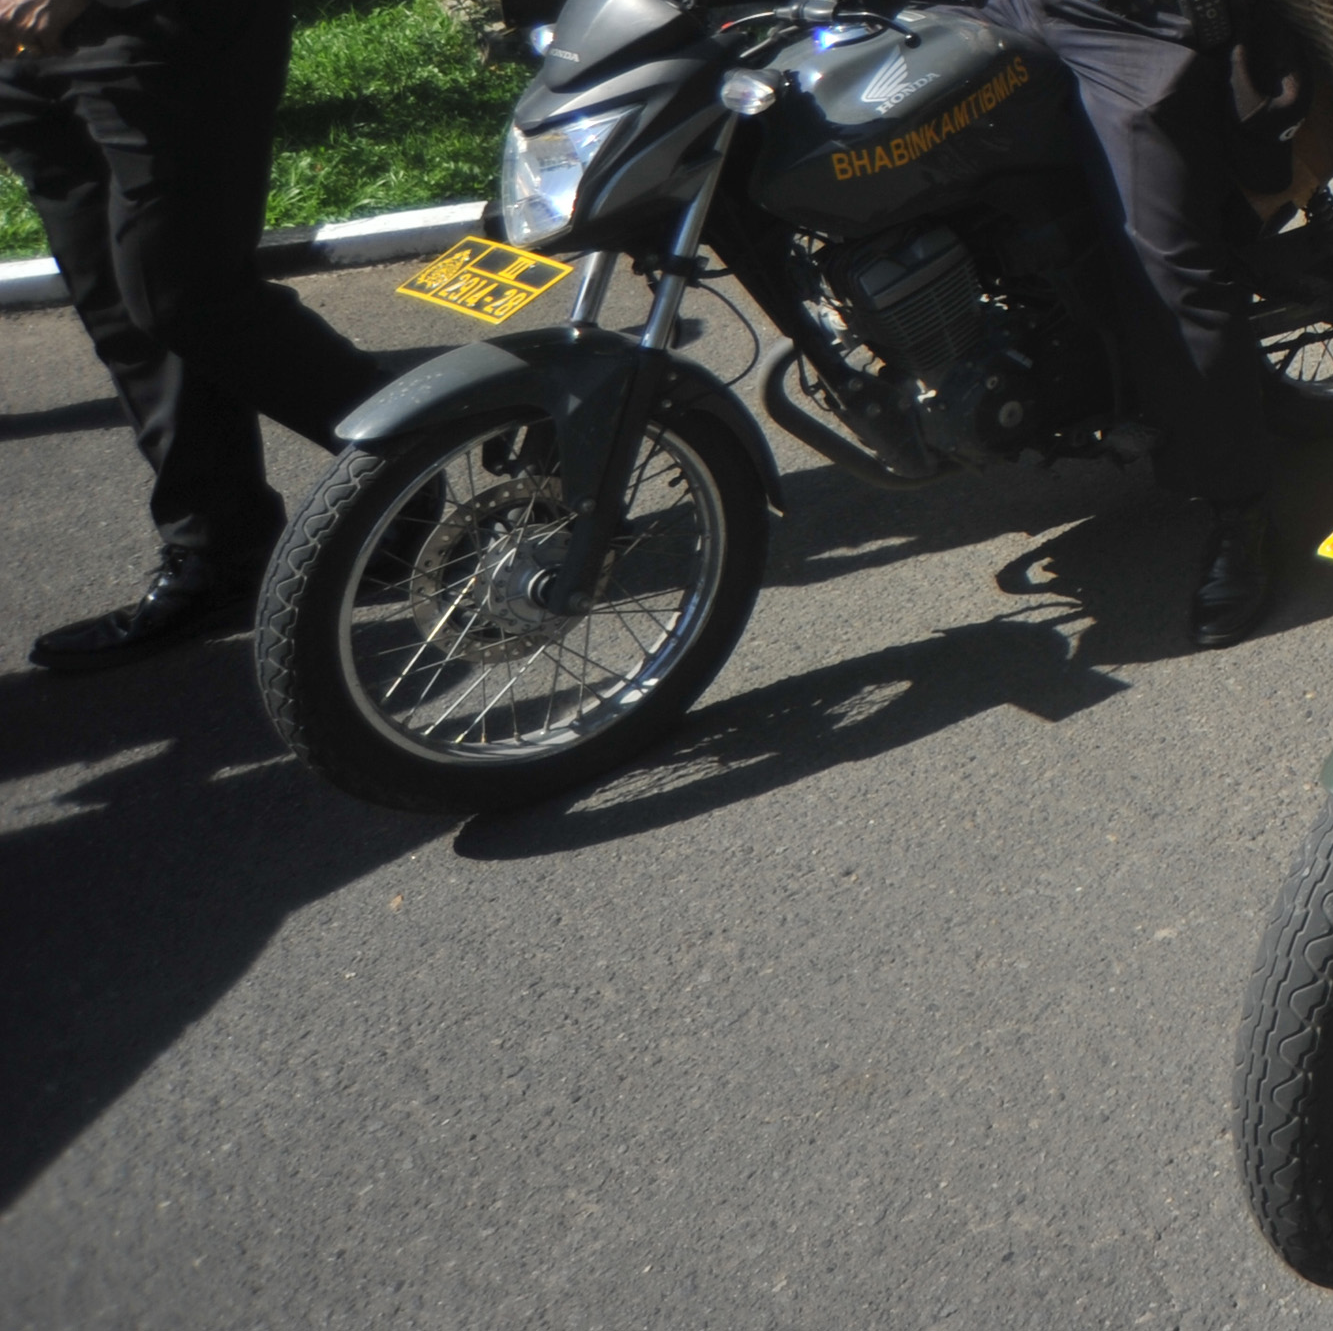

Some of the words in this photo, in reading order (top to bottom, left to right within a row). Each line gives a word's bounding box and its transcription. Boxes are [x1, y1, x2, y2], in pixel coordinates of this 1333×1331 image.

[549, 49, 580, 62] ONDA
[874, 72, 941, 115] HONDA
[832, 56, 1030, 181] BHABINKAMTIBMAS
[438, 273, 528, 316] 2914-28
